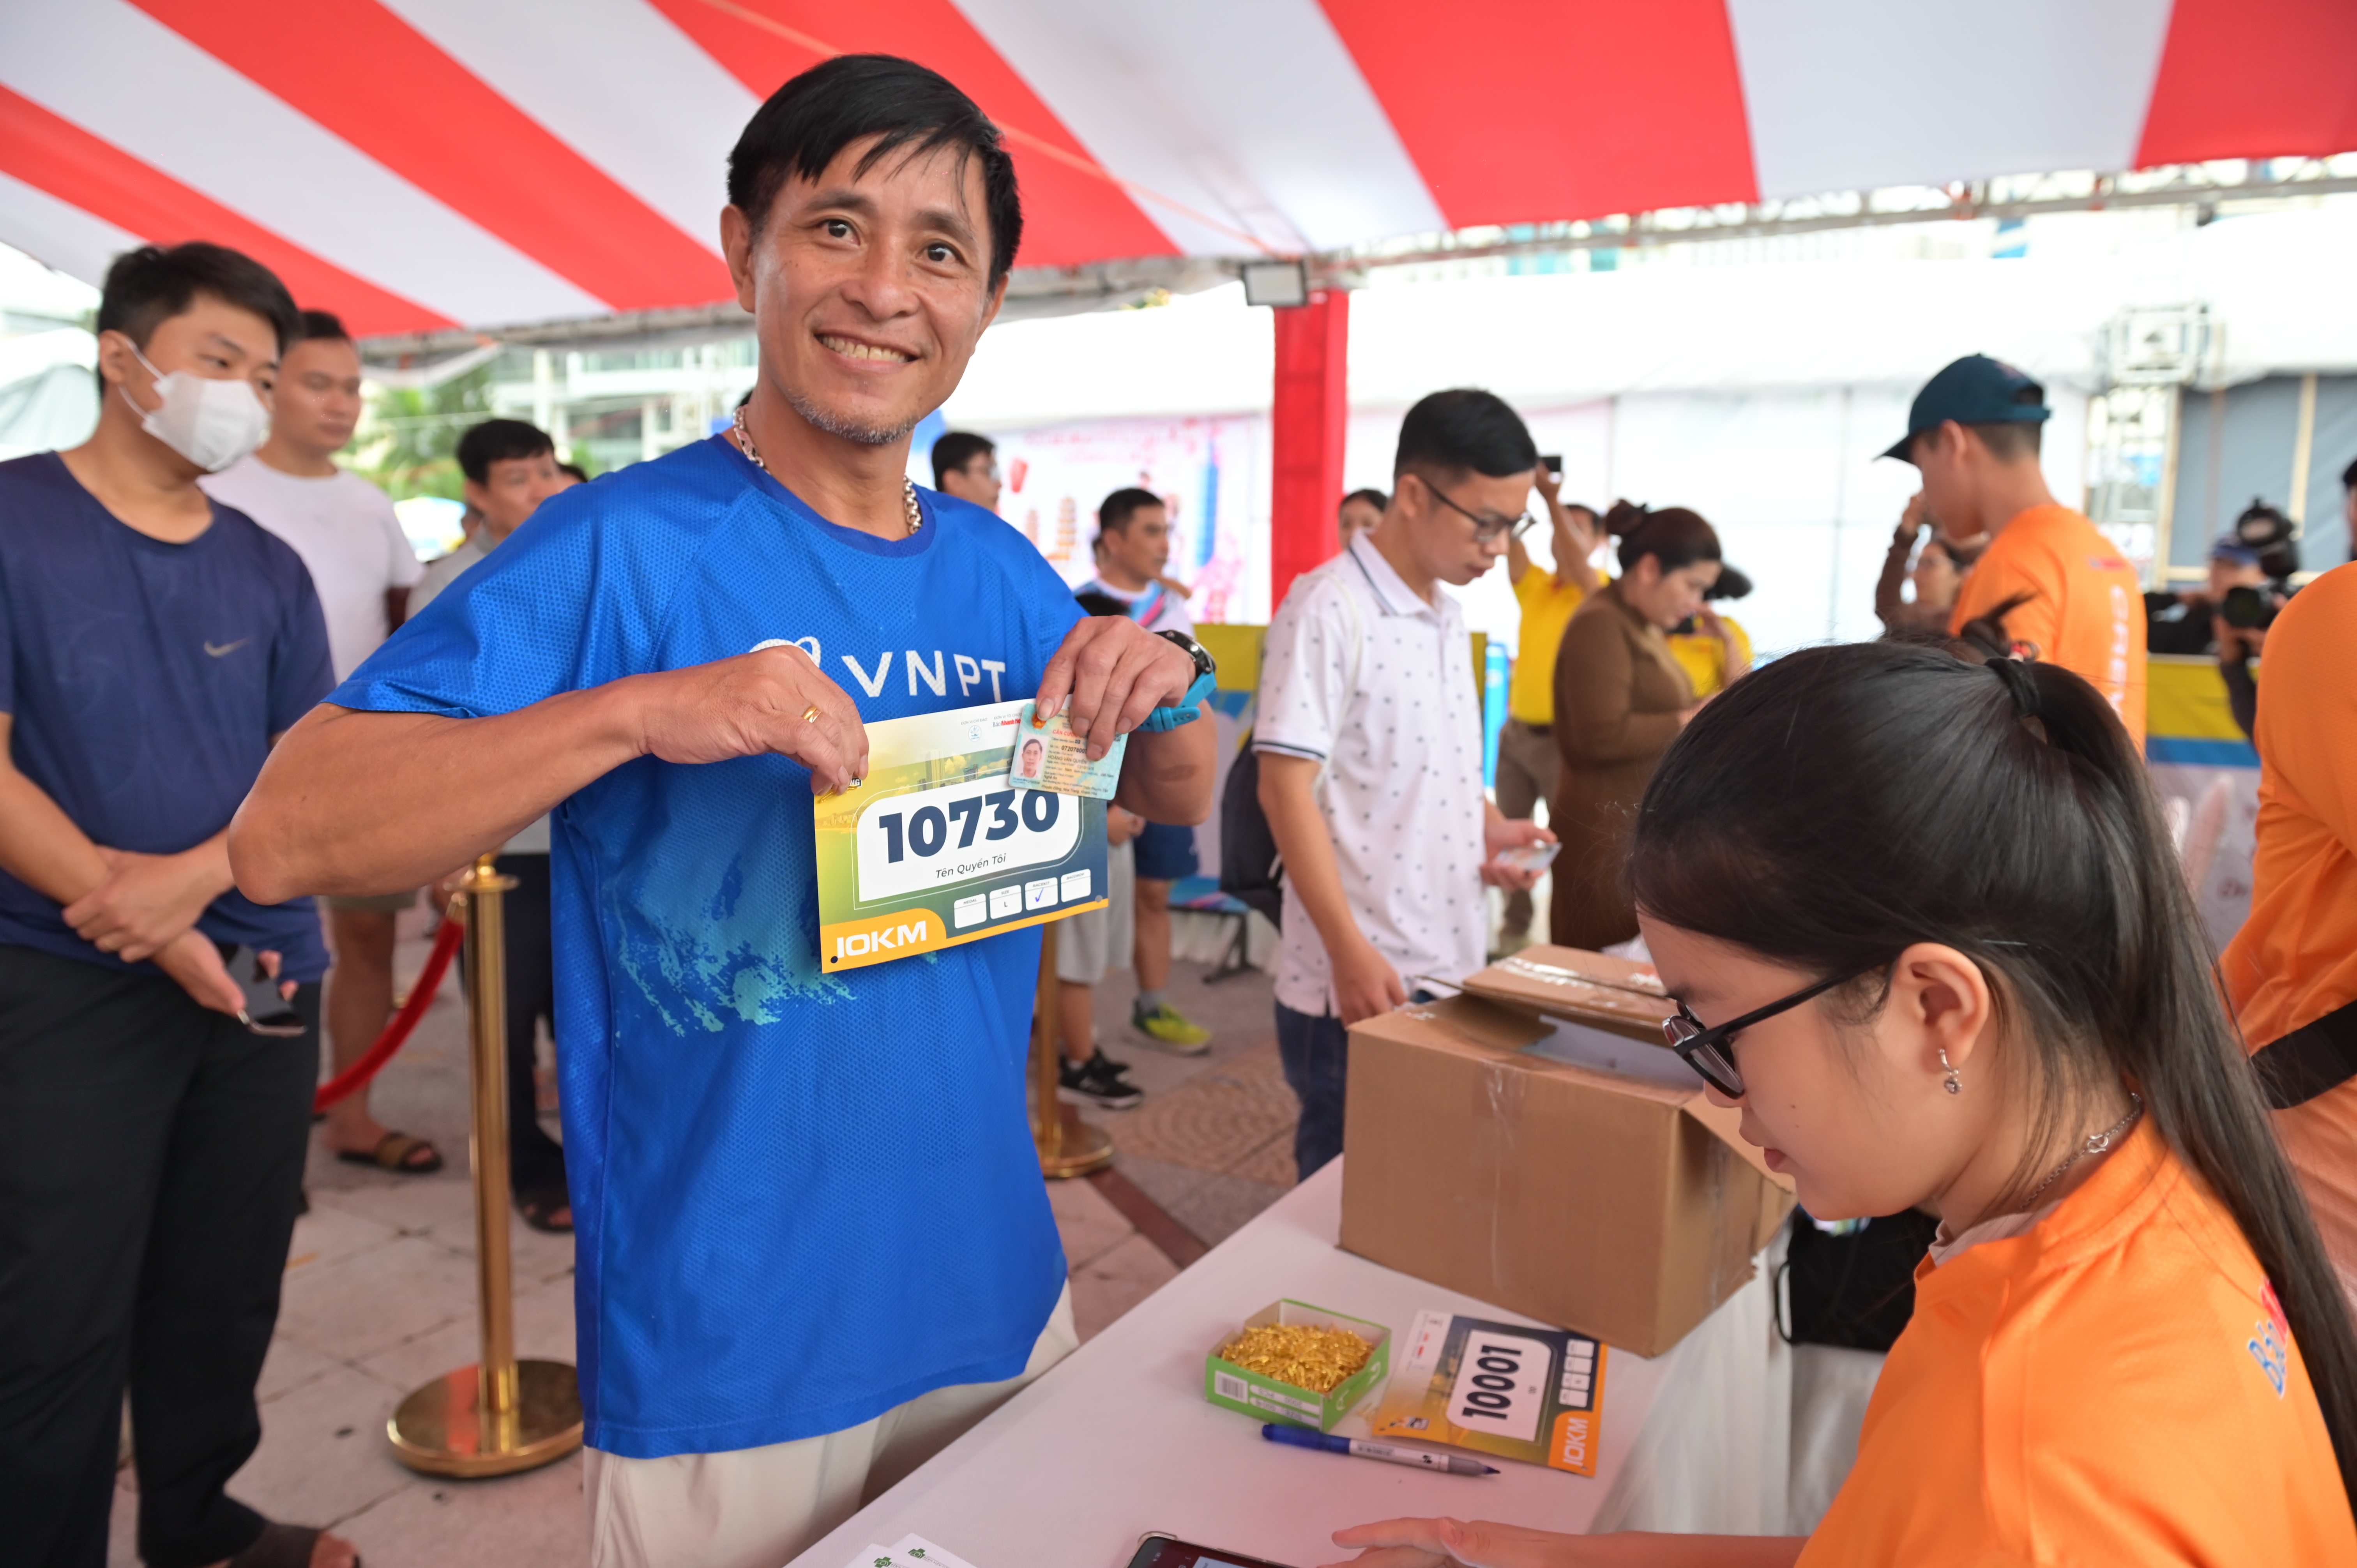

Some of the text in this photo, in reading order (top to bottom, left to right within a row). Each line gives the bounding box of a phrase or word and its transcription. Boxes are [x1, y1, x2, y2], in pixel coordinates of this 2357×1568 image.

[841, 650, 1006, 703] VNPT
[879, 789, 1059, 863] 10730
[936, 868, 953, 878] Tên
[992, 853, 1006, 864] Tôi
[1462, 1345, 1522, 1420] 10001
